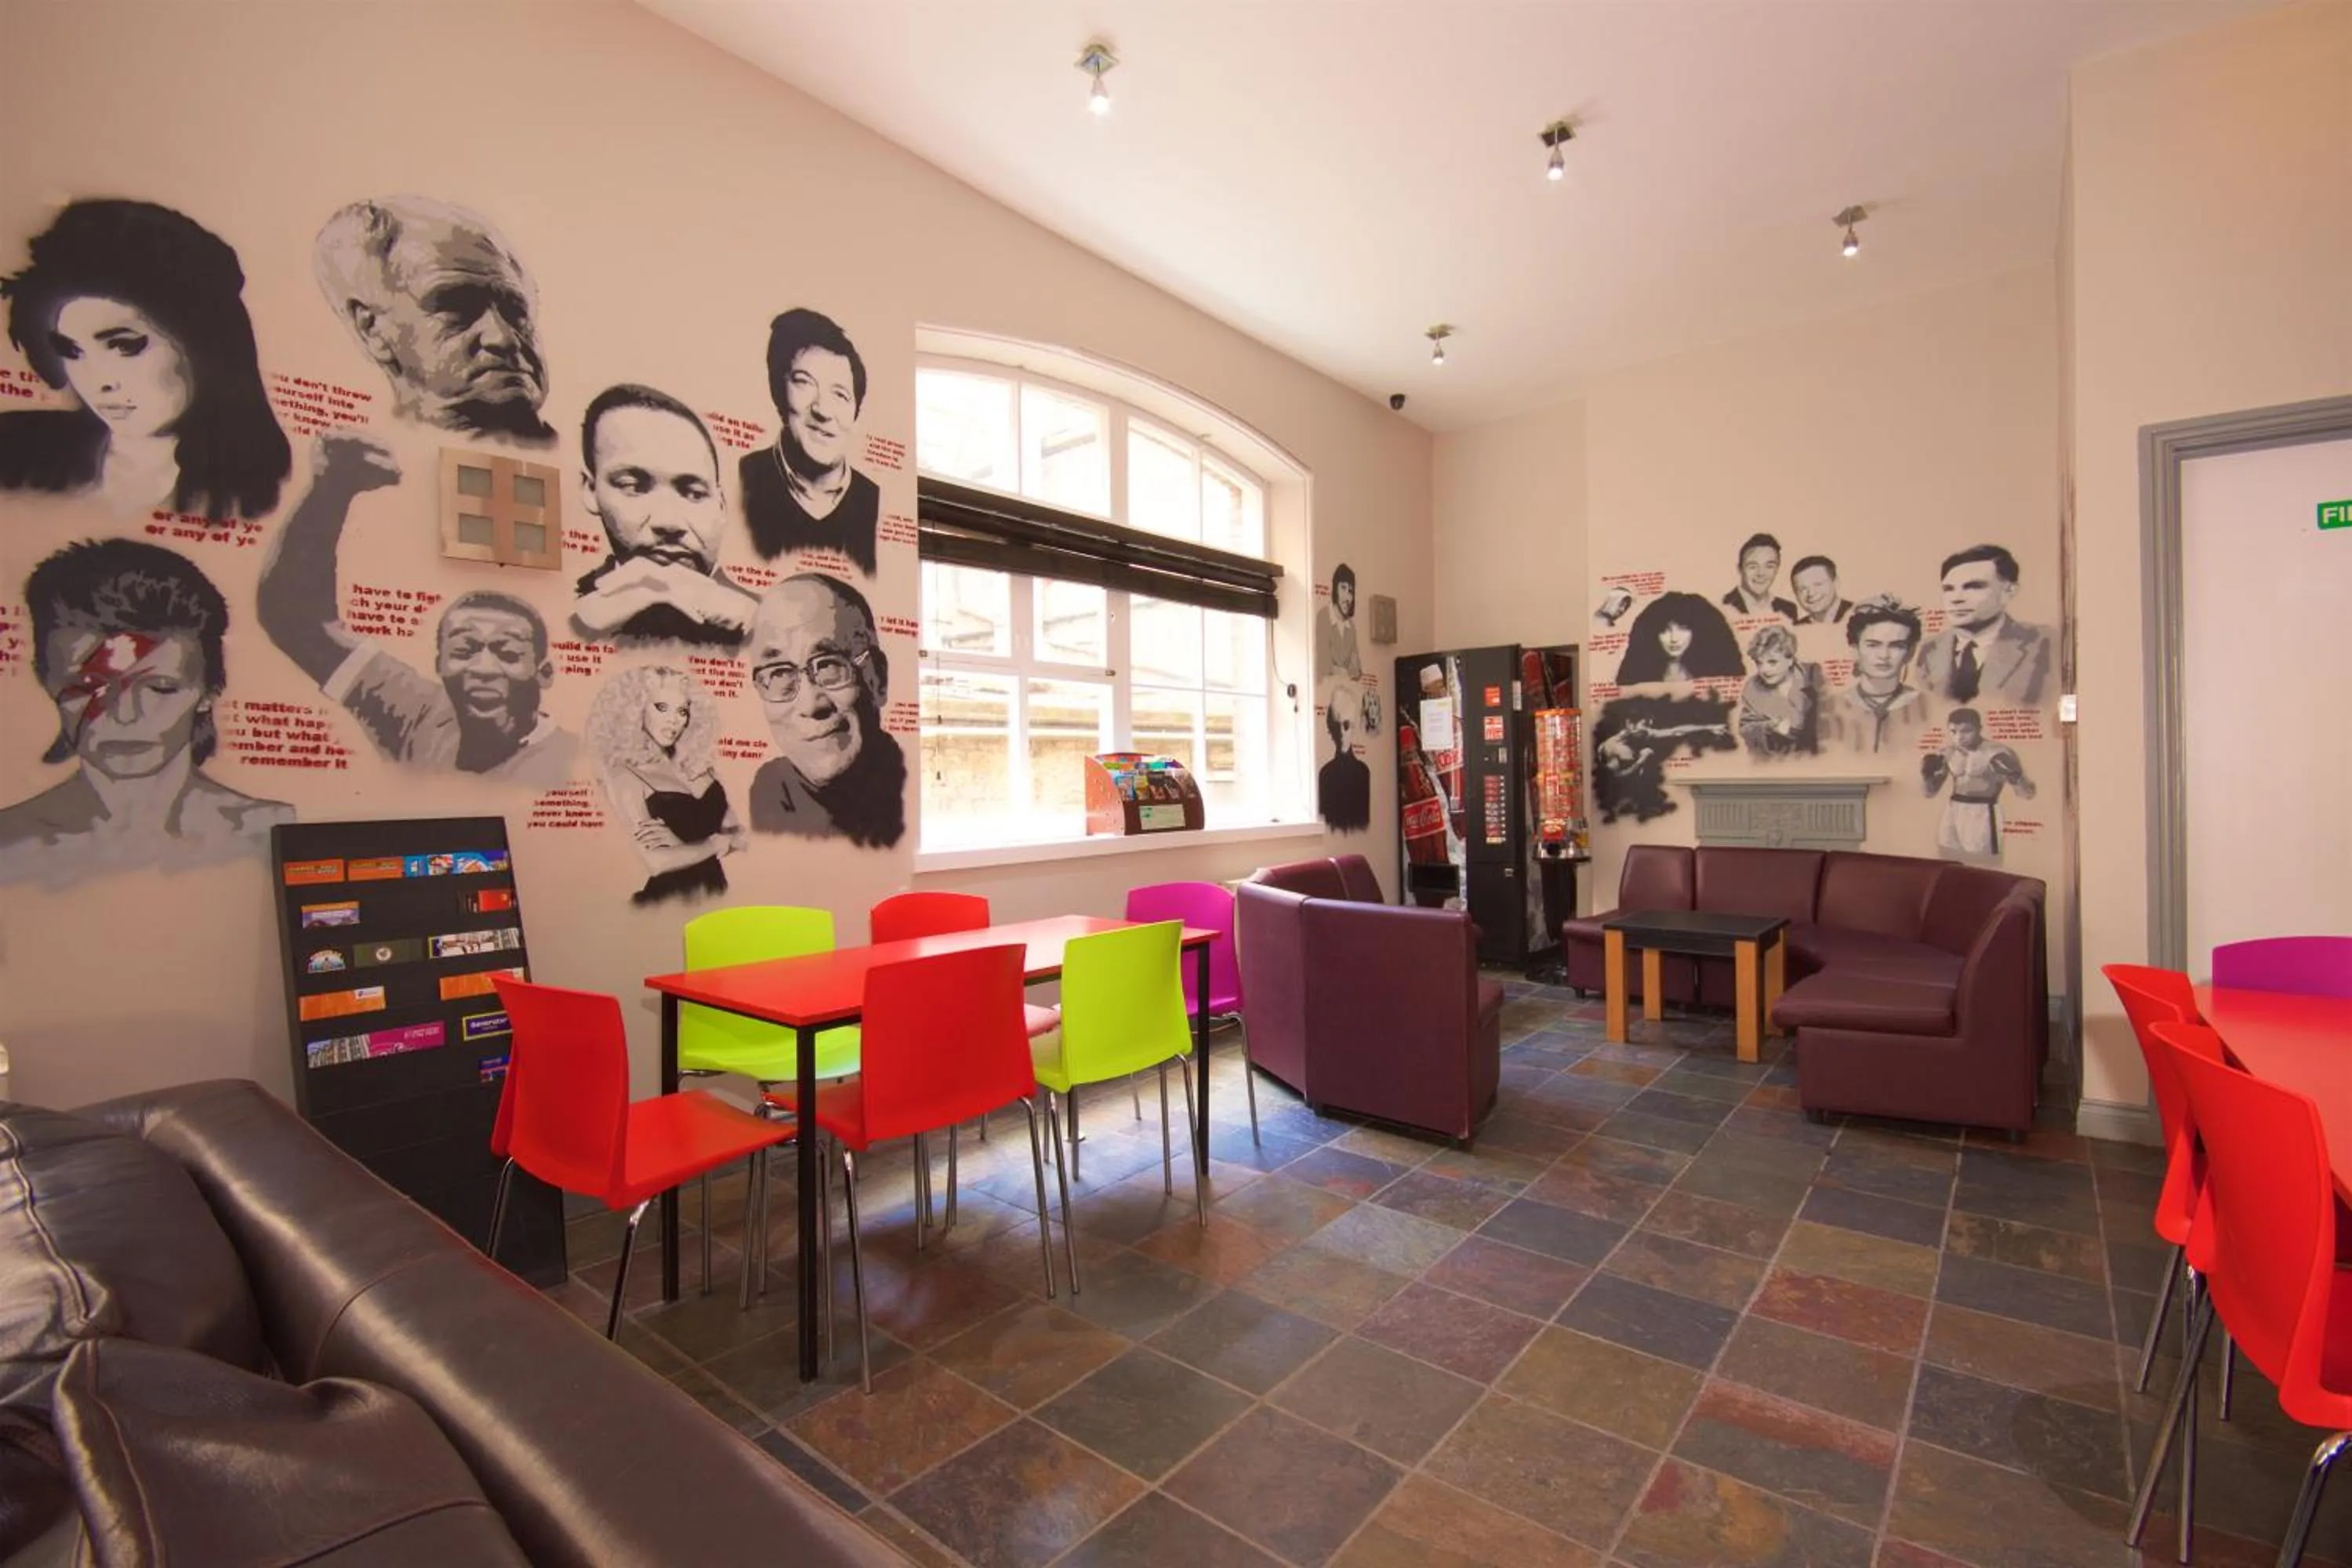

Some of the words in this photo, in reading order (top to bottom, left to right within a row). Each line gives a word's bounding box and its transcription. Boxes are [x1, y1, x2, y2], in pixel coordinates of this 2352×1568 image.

[152, 511, 174, 522] or
[180, 514, 211, 528] any
[221, 519, 236, 529] of
[144, 524, 165, 535] or
[172, 527, 206, 542] any
[211, 532, 230, 543] of
[352, 584, 391, 597] have
[396, 590, 412, 600] to
[375, 601, 409, 612] your
[346, 610, 384, 622] have
[390, 615, 405, 624] to
[350, 625, 391, 636] work
[584, 644, 600, 653] on
[593, 655, 601, 664] it
[245, 702, 313, 715] matters
[245, 715, 289, 727] what
[252, 727, 282, 739] but
[286, 731, 329, 742] what
[289, 744, 321, 756] and
[240, 755, 332, 768] remember
[336, 758, 348, 770] it
[527, 820, 546, 829] you
